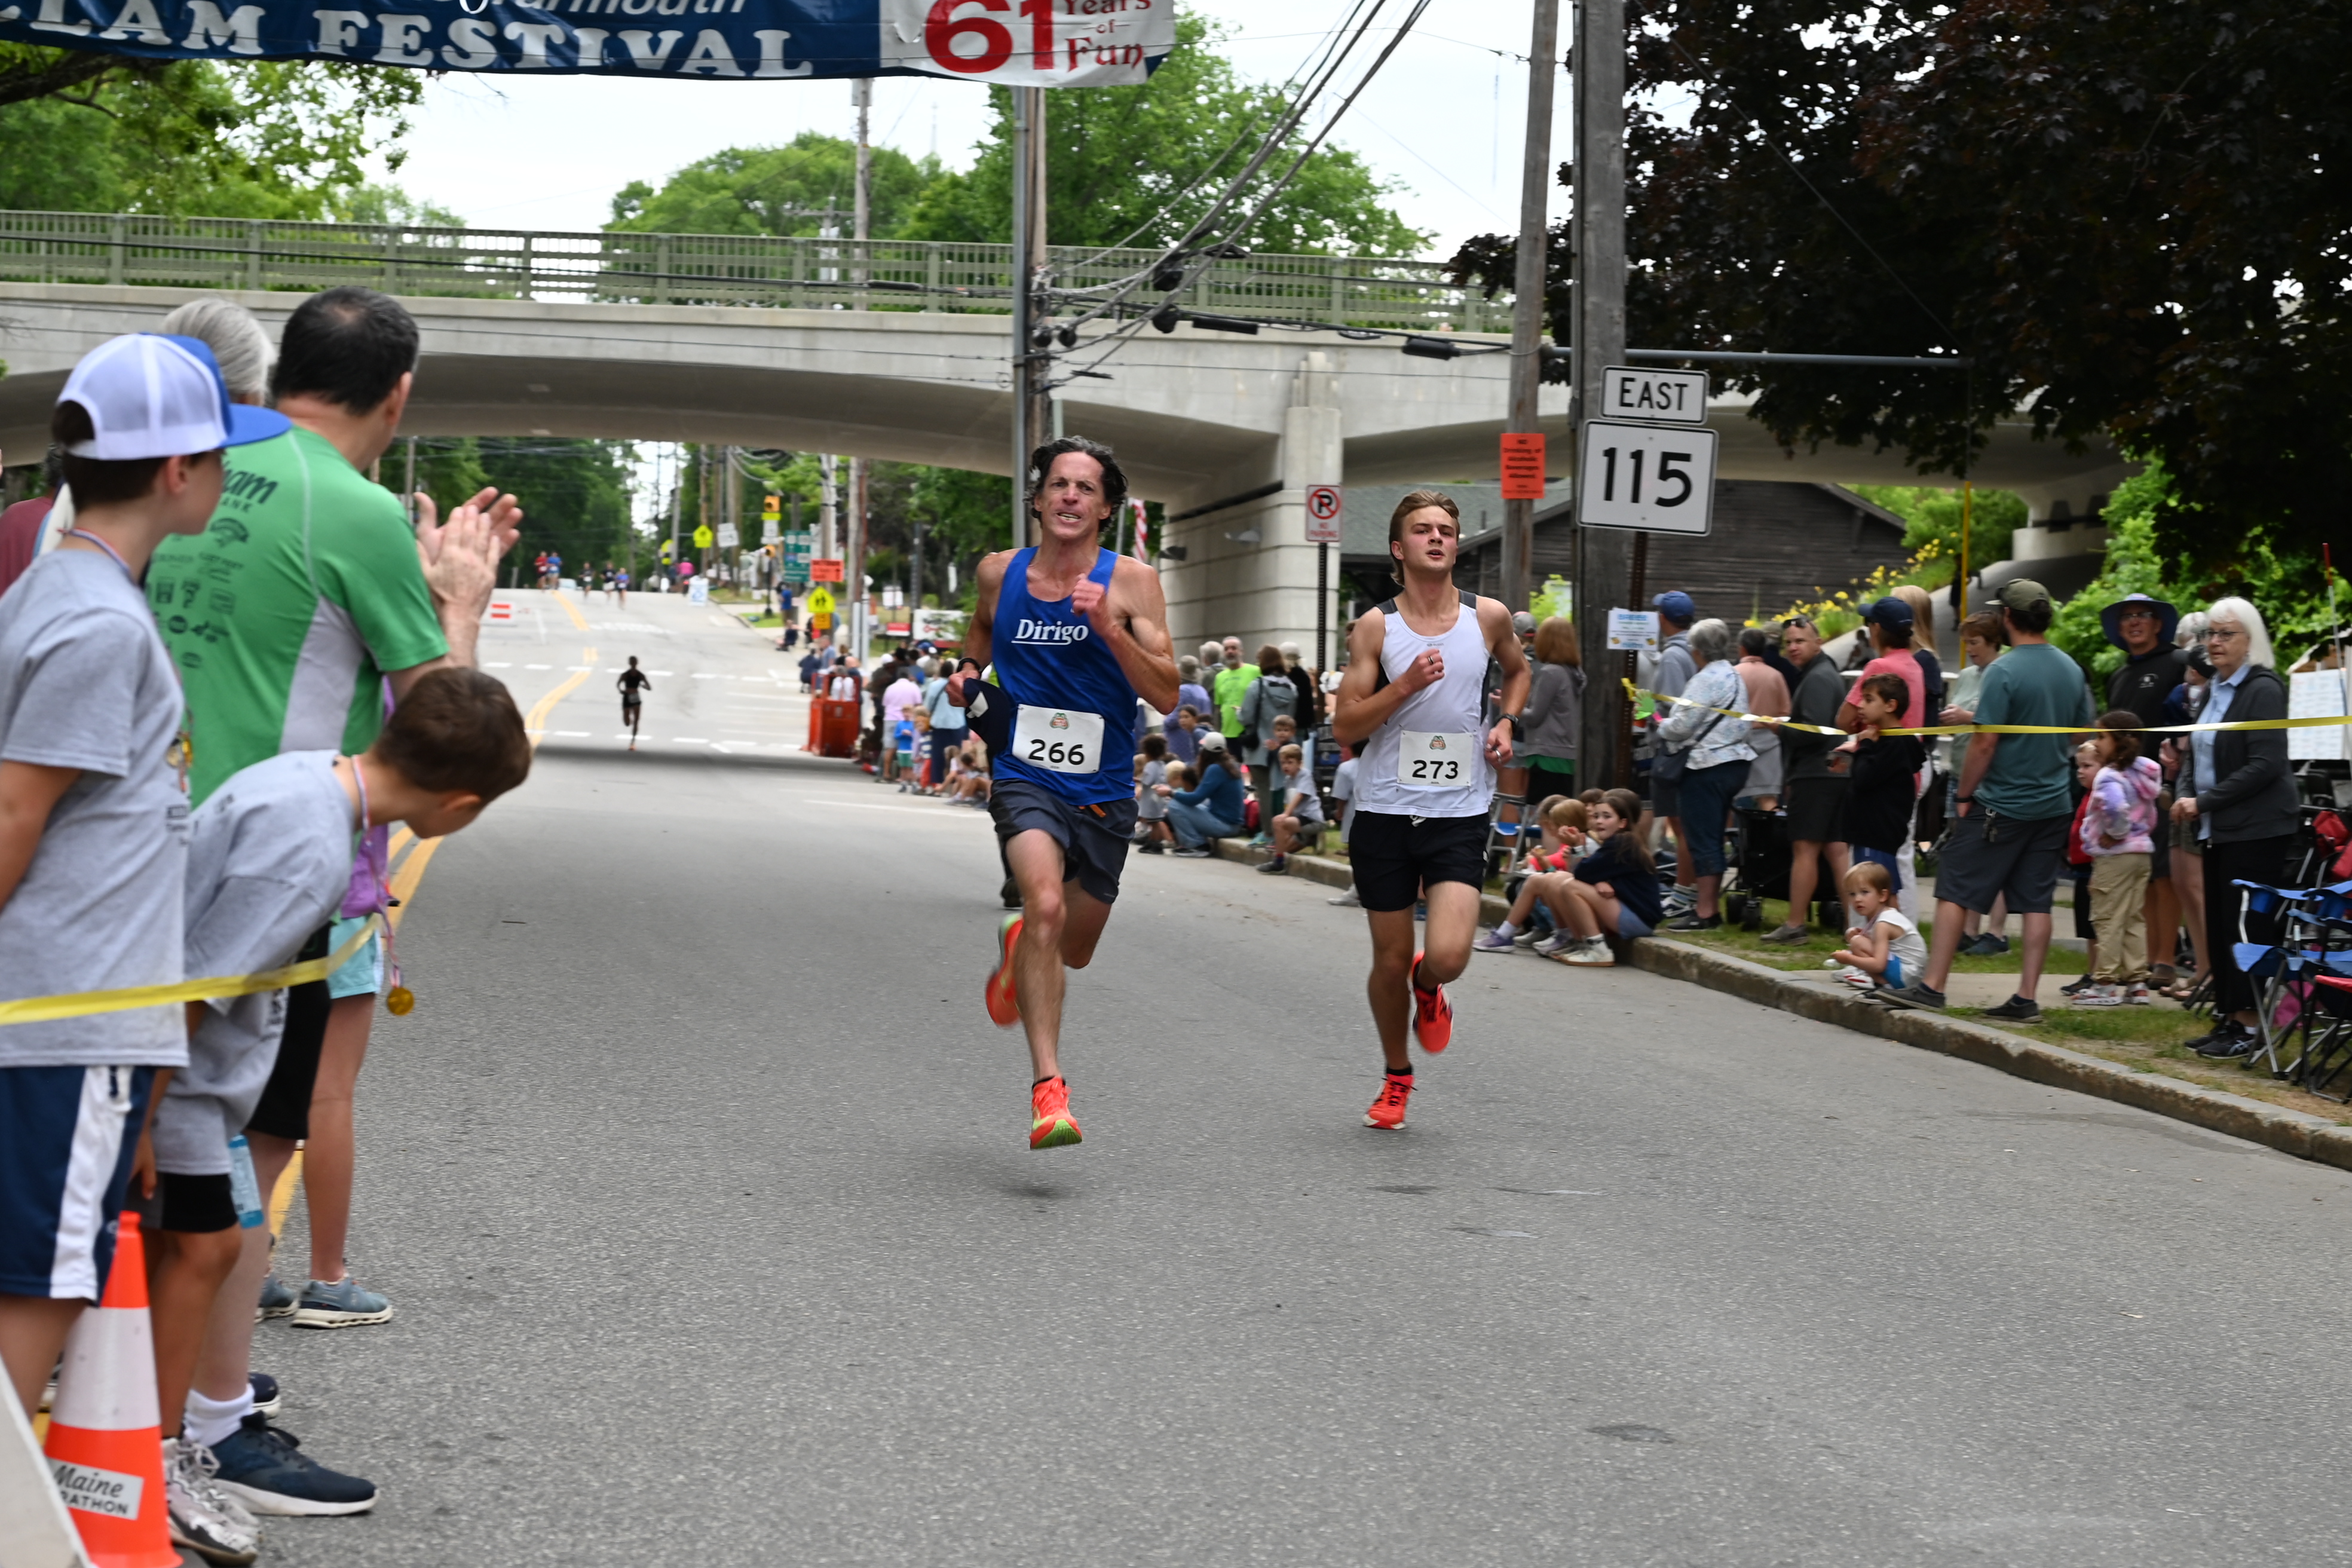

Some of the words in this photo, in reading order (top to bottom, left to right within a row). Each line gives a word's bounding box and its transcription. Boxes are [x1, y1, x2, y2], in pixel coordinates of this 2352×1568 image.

[1065, 0, 1151, 15] Years
[0, 0, 266, 54] LAM
[312, 10, 814, 76] FESTIVAL
[925, 0, 1054, 73] 61
[1096, 19, 1116, 33] of
[1064, 36, 1144, 73] Fun
[1619, 376, 1689, 411] EAST
[1603, 447, 1692, 507] 115
[1310, 529, 1338, 538] PARKING
[1012, 619, 1089, 645] Dirigo
[1028, 739, 1085, 765] 266
[1412, 760, 1459, 779] 273
[54, 1465, 124, 1498] Maine
[60, 1490, 128, 1515] ATHON
